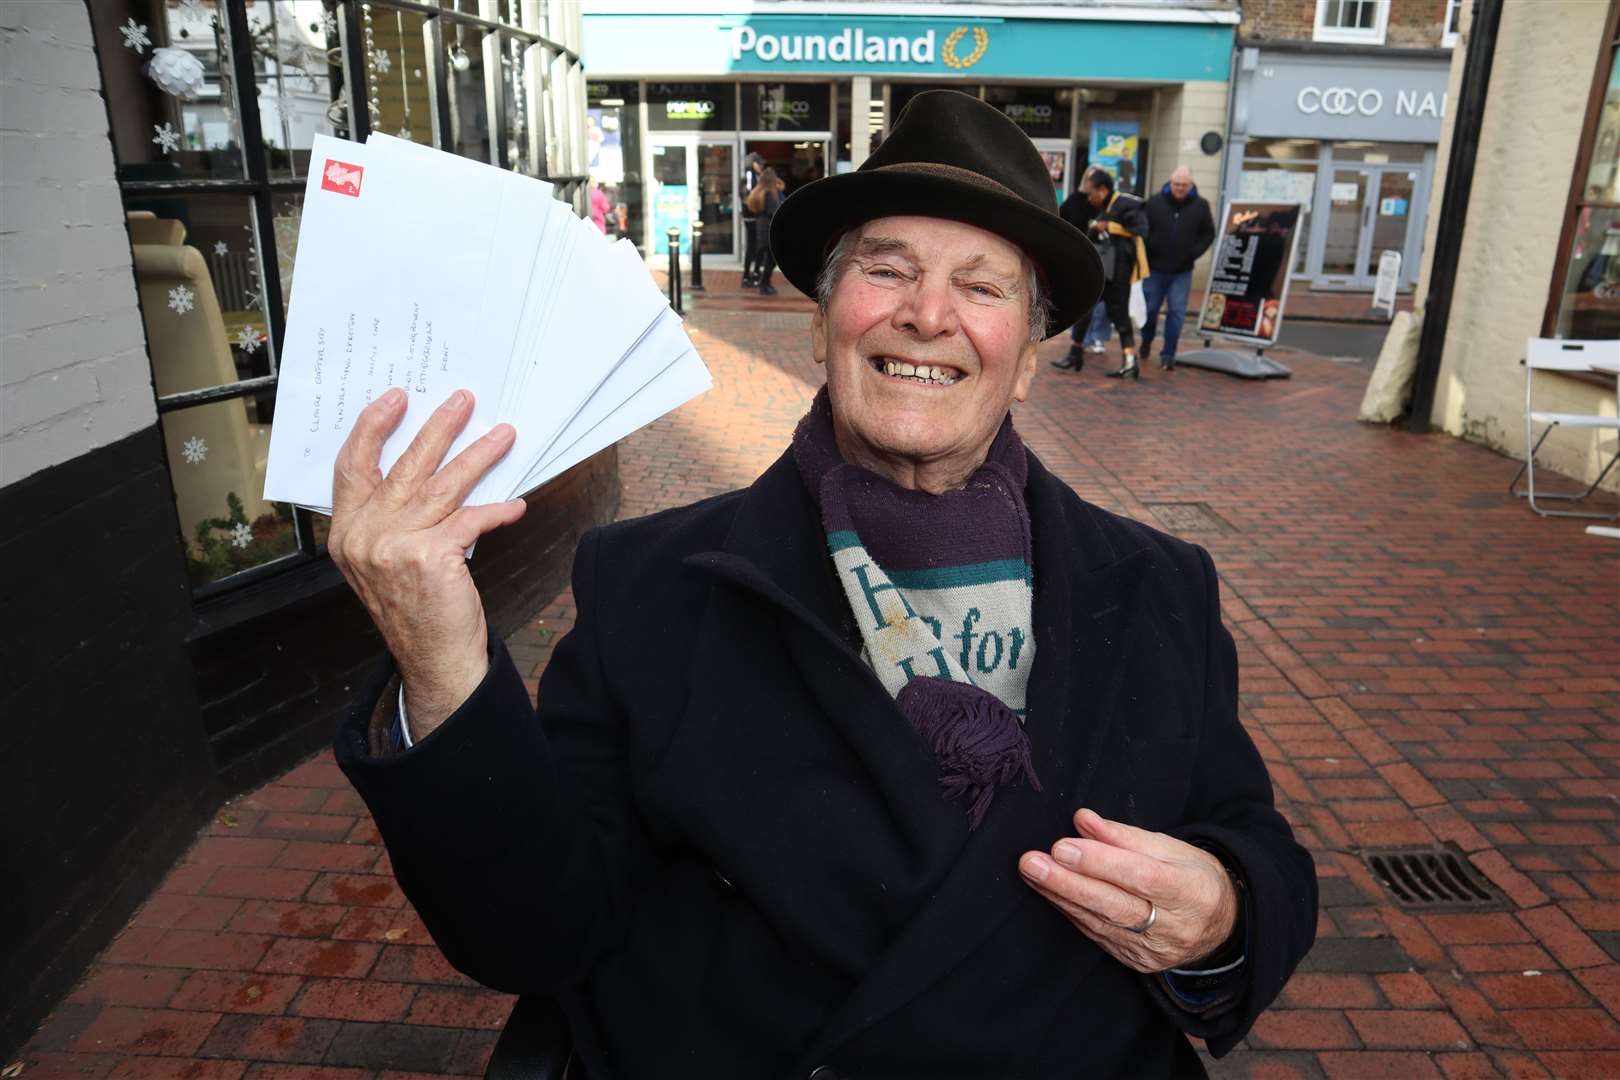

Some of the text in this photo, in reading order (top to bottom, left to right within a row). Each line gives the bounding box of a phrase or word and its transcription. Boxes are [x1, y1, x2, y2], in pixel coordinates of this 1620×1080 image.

[732, 26, 936, 63] Poundland
[1297, 86, 1383, 115] COCO
[953, 607, 1026, 674] for
